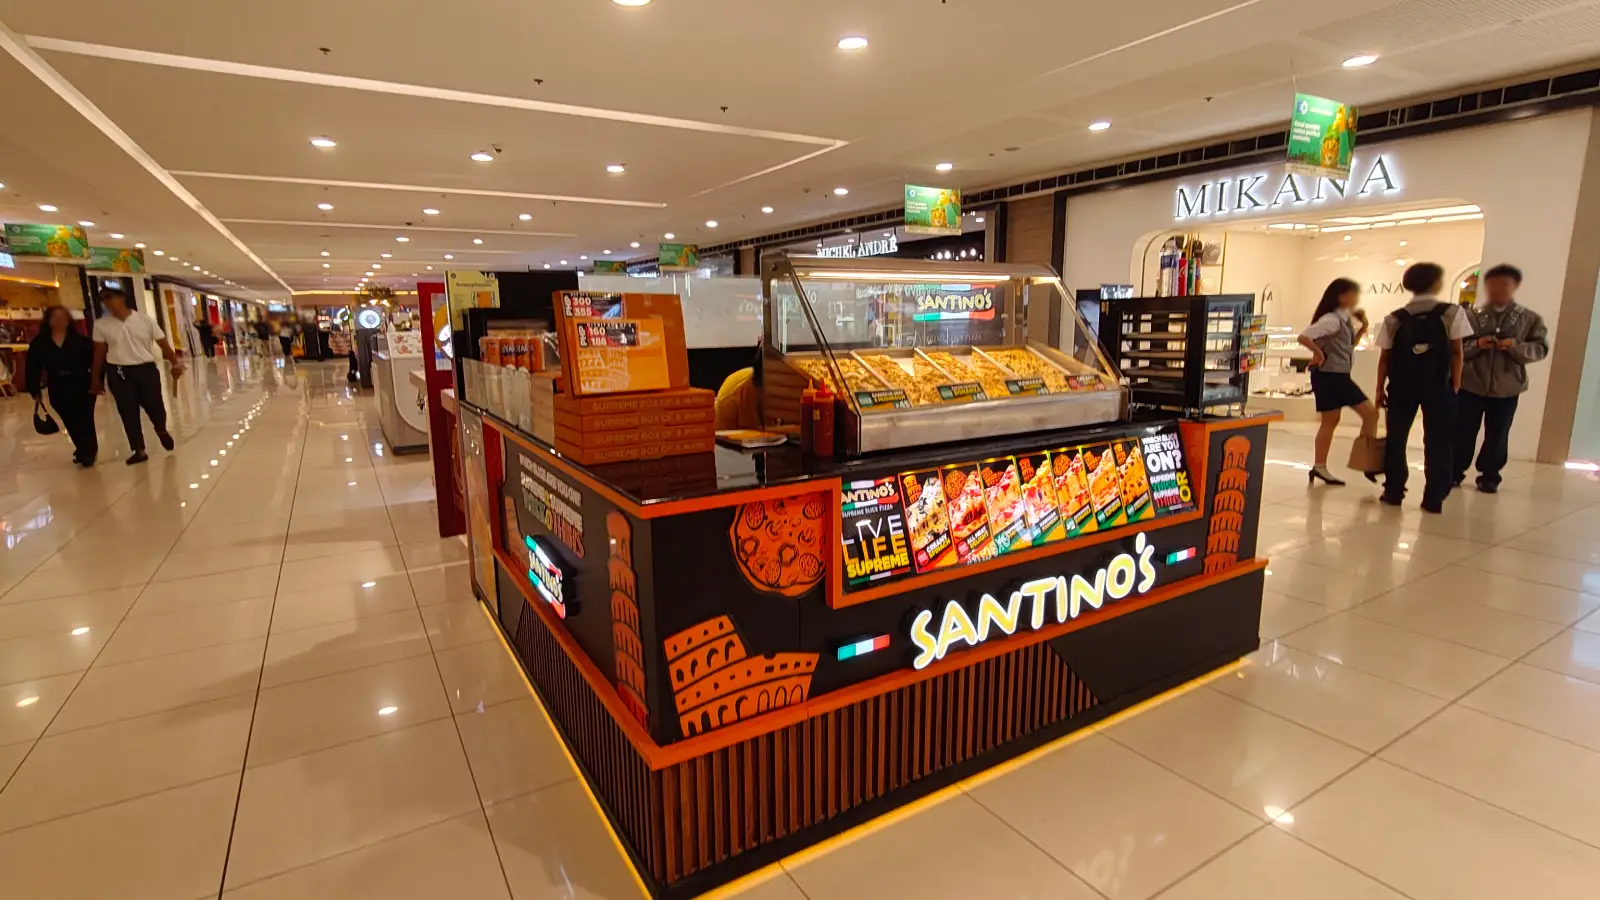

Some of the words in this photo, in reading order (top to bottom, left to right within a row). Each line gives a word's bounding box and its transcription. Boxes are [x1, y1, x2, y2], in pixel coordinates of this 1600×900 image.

[1173, 155, 1399, 219] MIKANA
[917, 288, 992, 311] SANTINO'S
[1144, 443, 1162, 454] ARE
[1162, 440, 1179, 450] YOU
[1147, 450, 1181, 473] ON?
[841, 481, 895, 503] ANTINO'S
[1176, 471, 1191, 502] OR
[841, 514, 903, 545] LIVE
[842, 533, 907, 565] LIFE
[926, 531, 948, 553] CREAMY
[928, 537, 951, 559] SPINACH
[847, 552, 910, 578] SUPREME
[911, 532, 1156, 670] SANTINO'S
